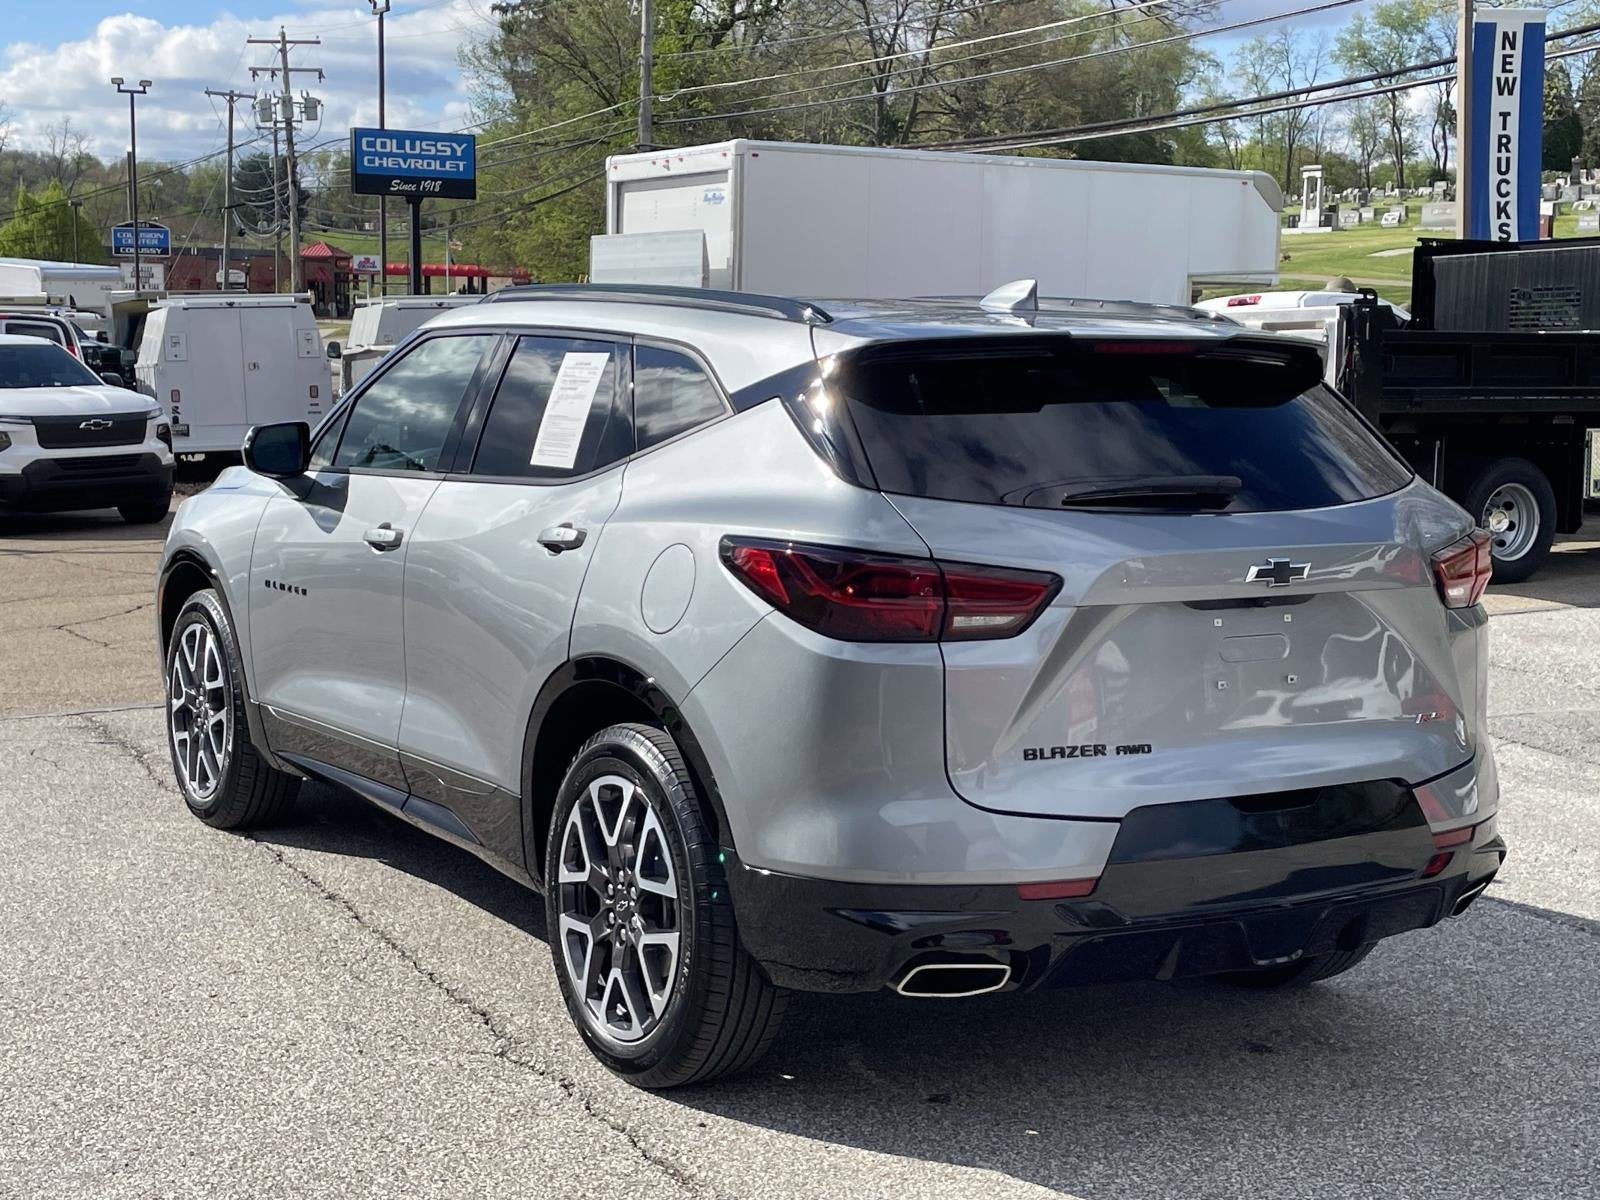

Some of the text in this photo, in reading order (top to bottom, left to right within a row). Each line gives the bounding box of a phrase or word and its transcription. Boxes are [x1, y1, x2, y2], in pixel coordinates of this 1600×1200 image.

[1496, 30, 1517, 242] NEW TRUCKS
[361, 137, 467, 157] COLUSSY
[363, 156, 467, 172] CHEVROLET
[389, 179, 442, 192] Since 1918
[1023, 743, 1153, 761] BLAZER AWD
